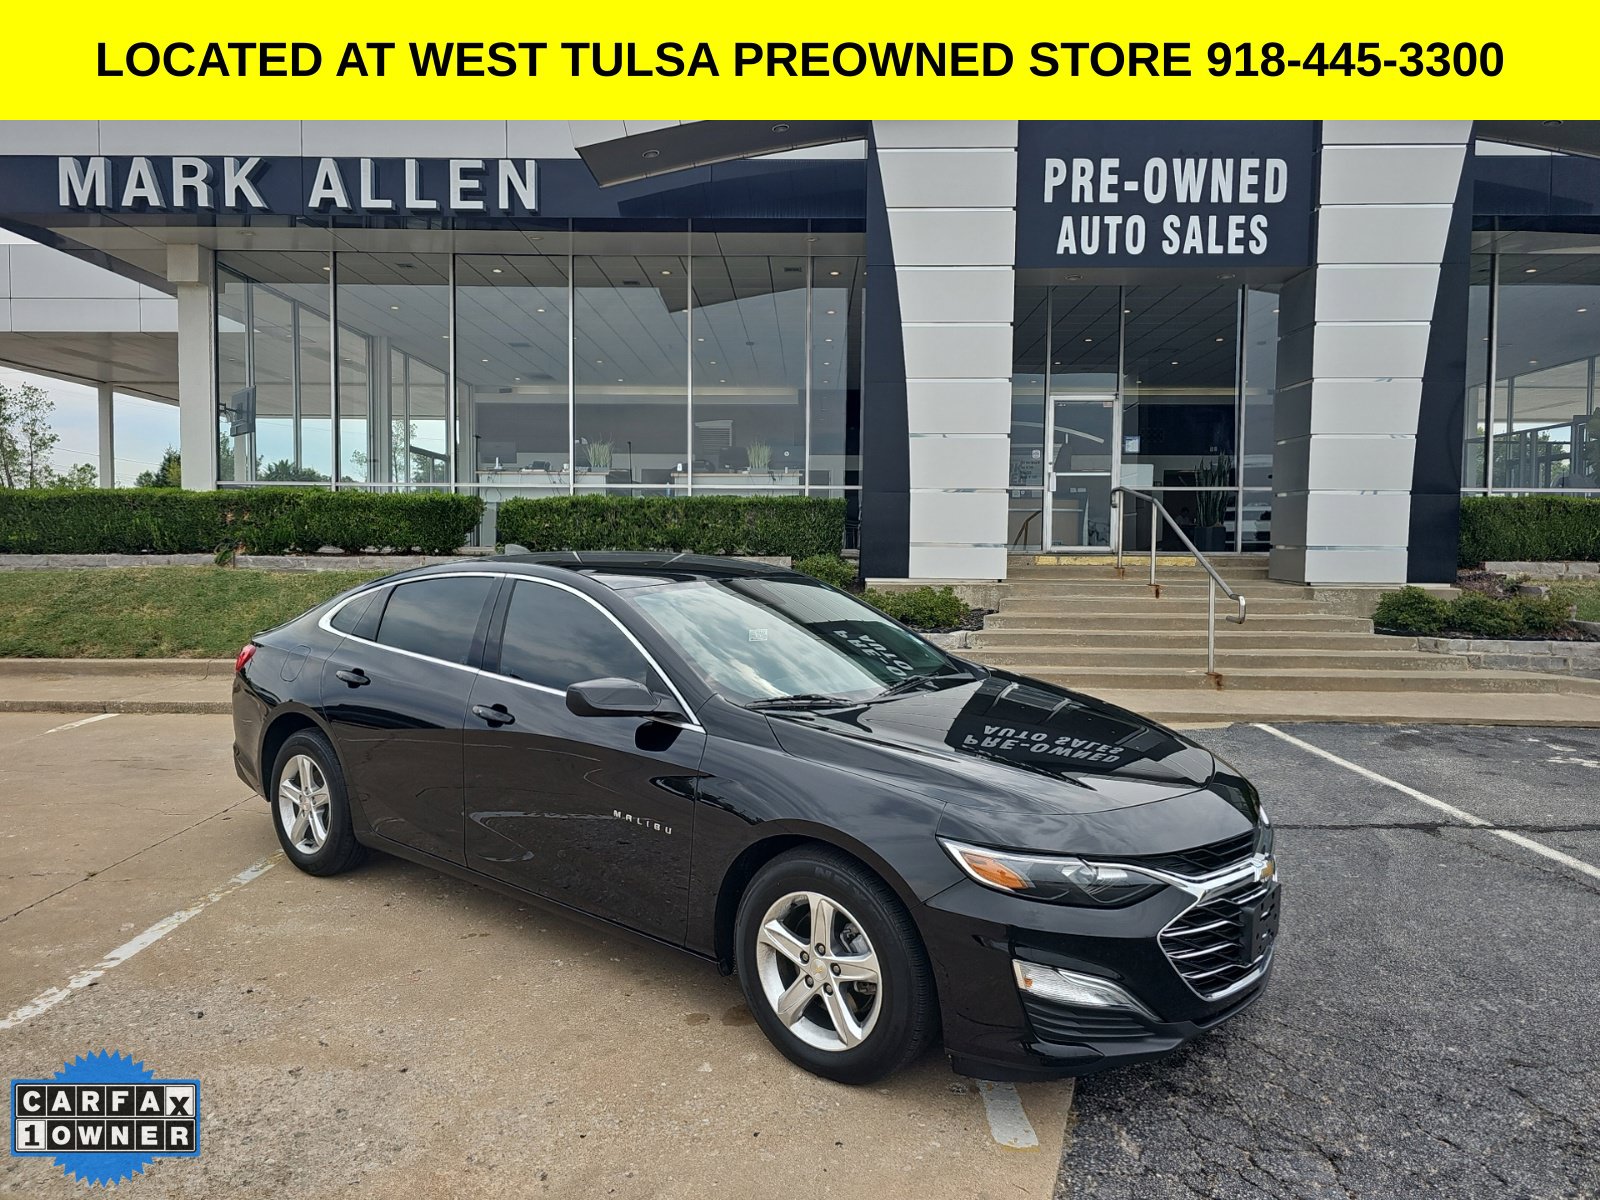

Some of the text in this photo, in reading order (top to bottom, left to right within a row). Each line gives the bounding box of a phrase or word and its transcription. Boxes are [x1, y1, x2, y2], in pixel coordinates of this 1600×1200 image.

[58, 157, 540, 212] MARK ALLEN
[1043, 157, 1288, 204] PRE-OWNED
[1056, 214, 1268, 255] AUTO SALES
[613, 809, 672, 834] MALIBU
